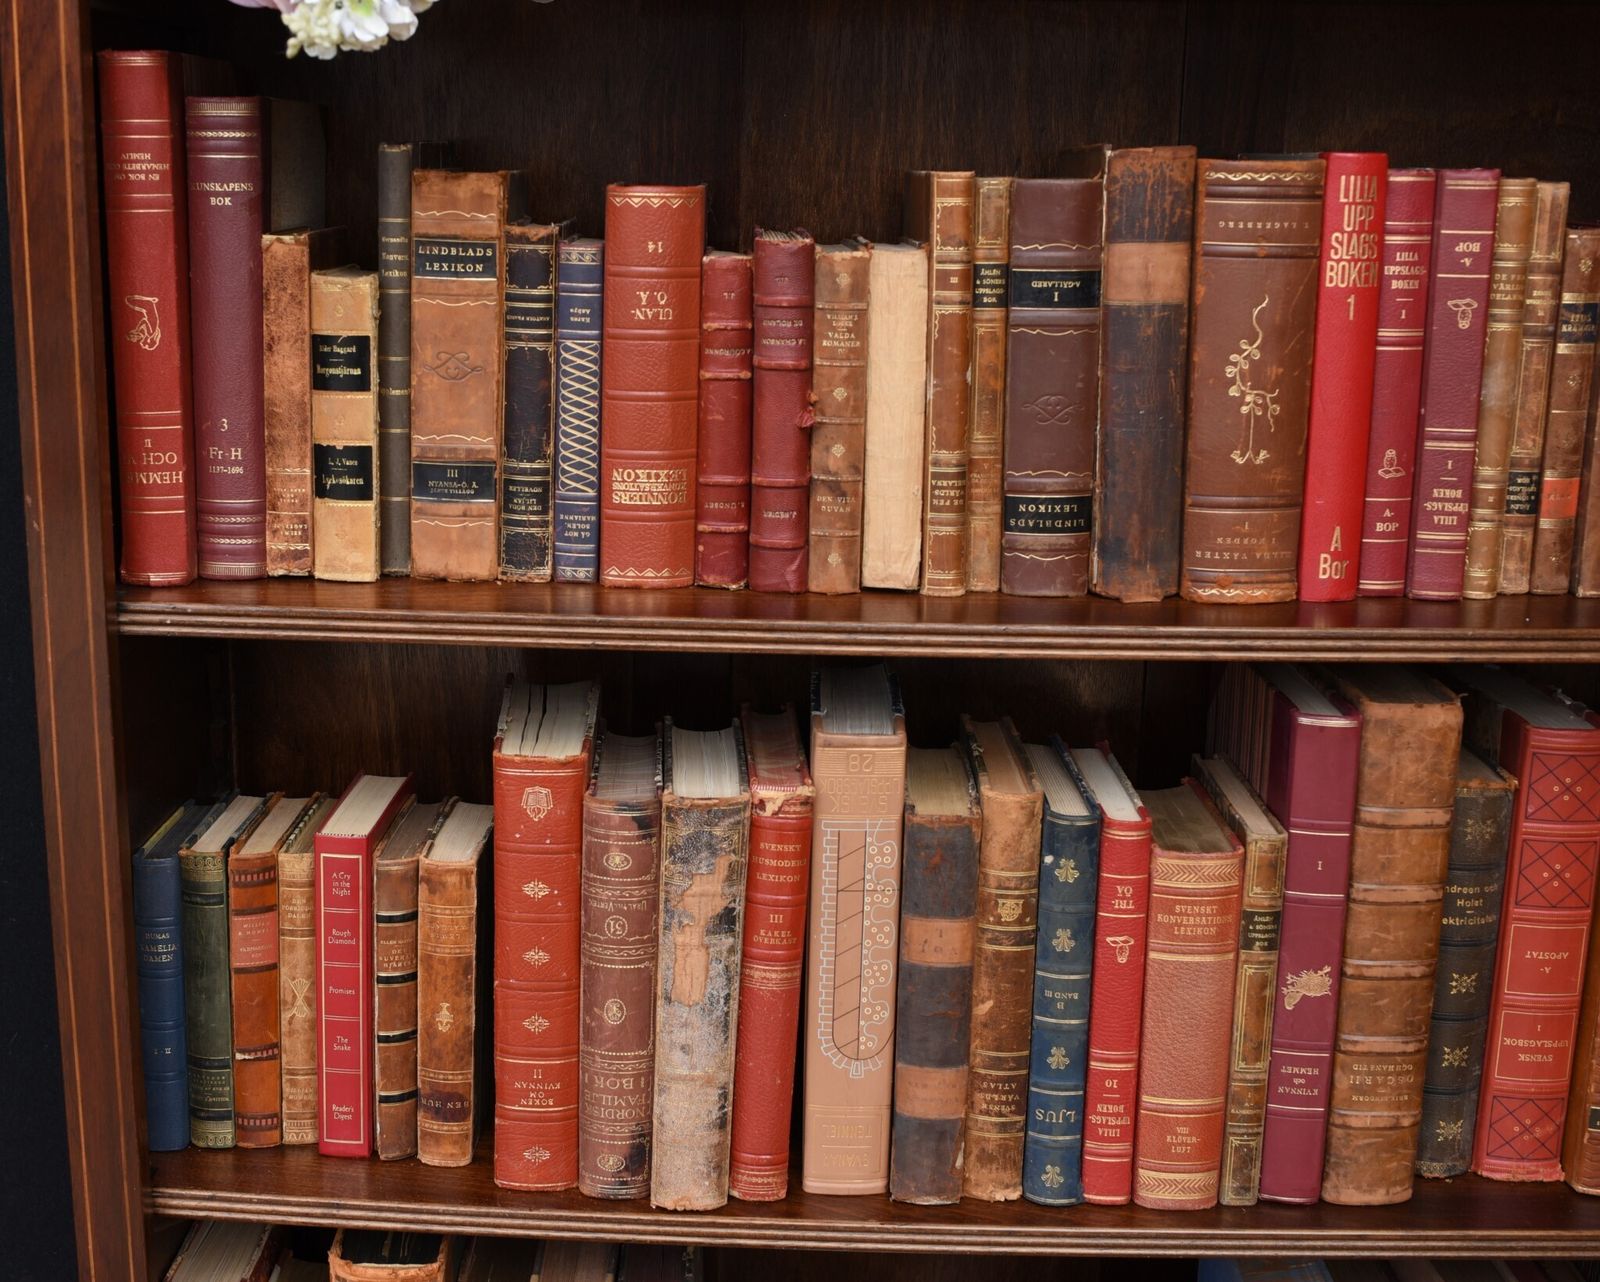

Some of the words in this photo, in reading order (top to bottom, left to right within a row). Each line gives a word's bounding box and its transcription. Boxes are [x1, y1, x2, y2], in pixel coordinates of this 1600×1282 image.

[128, 173, 147, 181] BOK
[148, 173, 160, 181] EN
[1339, 174, 1378, 203] LILLA
[209, 197, 233, 206] BOK
[1343, 203, 1375, 233] UPP
[1218, 220, 1298, 230] LAGERBERG
[418, 245, 494, 257] LINDBLADS
[647, 240, 665, 254] 14
[1330, 231, 1378, 262] SLAGS
[1454, 241, 1481, 253] BOP
[1395, 251, 1419, 262] LILLA
[1460, 257, 1473, 267] A-
[425, 262, 485, 273] LEXIKON
[1384, 265, 1429, 277] UPPSLAGS-
[1325, 260, 1379, 289] BOKEN
[1494, 272, 1508, 281] DE
[1390, 278, 1420, 290] BOKEN
[1053, 291, 1060, 302] I
[1346, 294, 1356, 321] 1
[630, 308, 673, 321] ULAN-
[1400, 309, 1407, 320] 1
[827, 331, 857, 339] VALDA
[761, 338, 798, 347] CHANSON
[219, 418, 228, 432] 3
[143, 438, 153, 448] II
[141, 451, 178, 466] OCH
[447, 469, 458, 478] III
[611, 468, 688, 483] LEXIKON
[508, 485, 543, 493] NOVELLER
[612, 481, 688, 492] KONVERSATIONS
[612, 490, 688, 505] BONNIERS
[1432, 488, 1463, 500] BOKEN
[513, 497, 537, 505] LILJAN
[527, 504, 543, 512] DEN
[1018, 503, 1078, 514] LEXIKON
[1383, 508, 1395, 518] A-
[1423, 501, 1470, 514] UPPSLAGS-
[559, 514, 597, 522] MARIANNE
[1009, 517, 1085, 529] LINDBLADS
[1432, 515, 1459, 526] LILLA
[1375, 521, 1400, 532] BOP
[563, 530, 579, 539] MOT
[1330, 525, 1342, 552] A
[1216, 537, 1266, 546] NORDEN
[1318, 552, 1349, 581] Bor
[849, 753, 874, 773] 28
[759, 841, 802, 852] SVENSKT
[752, 855, 807, 868] HUSMODERS
[331, 871, 338, 879] A
[338, 870, 351, 882] Cry
[756, 871, 801, 883] LEXIKON
[332, 880, 339, 888] in
[340, 880, 351, 888] the
[332, 887, 351, 897] Night
[1456, 897, 1484, 908] Holst
[1175, 904, 1219, 915] SVENSKT
[769, 913, 785, 924] III
[1156, 912, 1235, 925] KONVERSATIONS
[332, 927, 352, 939] Rough
[759, 928, 794, 939] KAKEL
[1173, 926, 1217, 936] LEXIKON
[327, 935, 357, 946] Diamond
[143, 953, 174, 963] DAMEN
[1524, 950, 1569, 961] APOSTAT
[1539, 966, 1552, 975] A-
[328, 985, 356, 996] Promises
[1044, 989, 1053, 998] III
[1054, 991, 1079, 1001] BAND
[1056, 1001, 1065, 1010] B
[335, 1034, 350, 1044] The
[1503, 1037, 1570, 1049] UPPSLAGSBOK
[333, 1042, 352, 1052] Snake
[1517, 1053, 1554, 1062] SVENSK
[1280, 1064, 1320, 1076] HEMMET
[1352, 1063, 1369, 1072] TID
[533, 1068, 543, 1079] II
[593, 1074, 634, 1091] BOK
[982, 1081, 1018, 1090] ATLAS
[1104, 1079, 1118, 1089] 10
[1292, 1076, 1307, 1086] och
[1363, 1073, 1415, 1087] OSCAR
[514, 1081, 561, 1091] KVINNAN
[1277, 1085, 1320, 1097] KVINNAN
[529, 1091, 545, 1099] OM
[584, 1089, 646, 1107] FAMILJE
[446, 1101, 470, 1110] BEN
[519, 1098, 555, 1107] BOKEN
[332, 1103, 355, 1114] Reader's
[584, 1101, 646, 1120] NORDISK
[1096, 1103, 1125, 1114] BOKEN
[333, 1111, 353, 1121] Digest
[1034, 1108, 1076, 1124] LJUS
[1088, 1114, 1132, 1126] UPPSLAGS-
[1097, 1127, 1121, 1137] LILLA
[1176, 1126, 1190, 1135] VIII
[1166, 1134, 1201, 1144] KLÖVER-
[1171, 1145, 1193, 1154] LUFT
